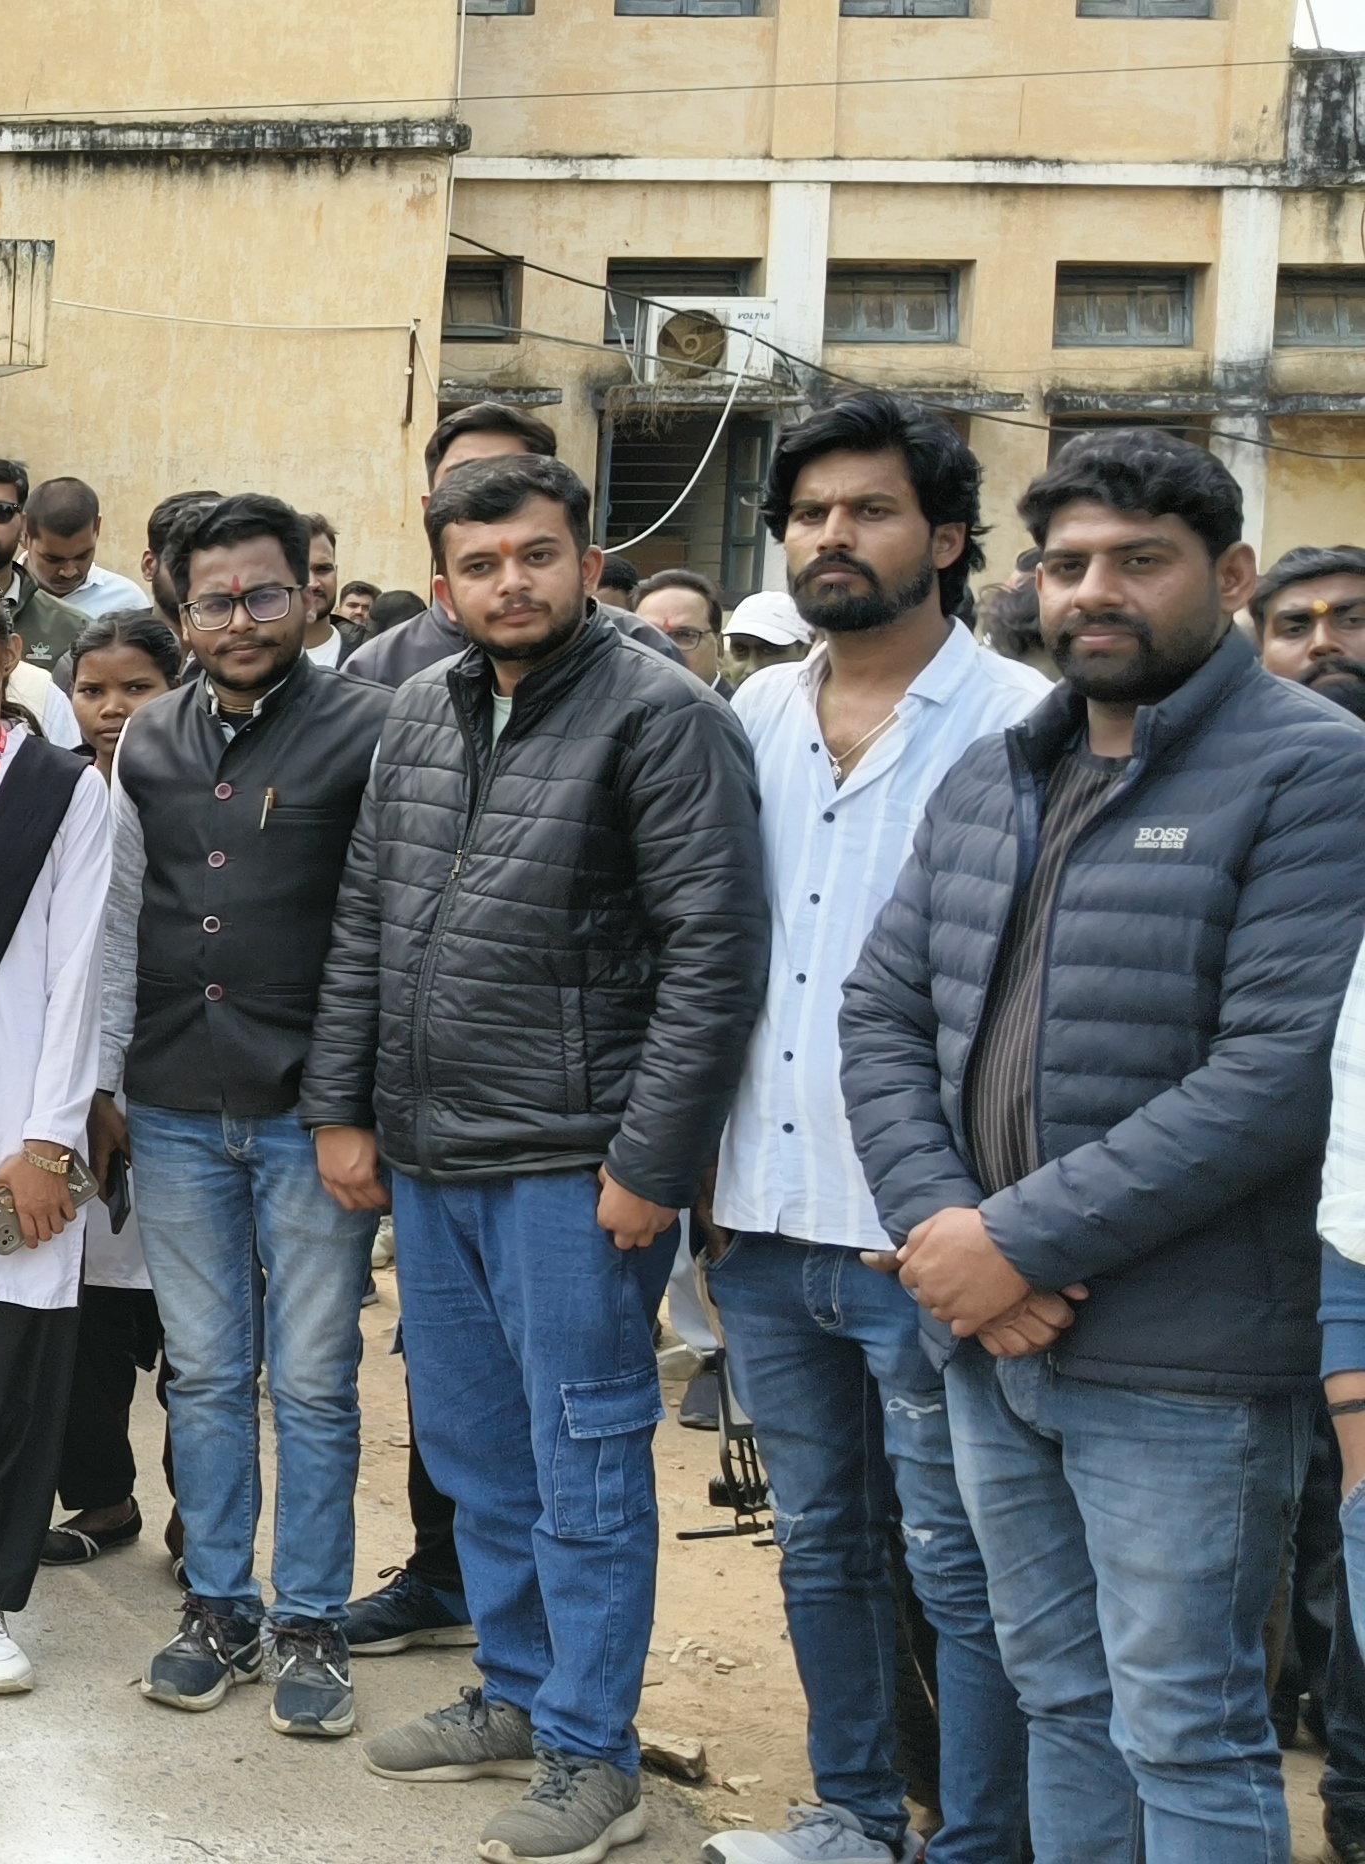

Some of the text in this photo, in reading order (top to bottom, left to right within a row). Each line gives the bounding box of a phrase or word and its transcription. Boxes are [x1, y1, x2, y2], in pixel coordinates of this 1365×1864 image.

[737, 312, 771, 320] VOLTAS
[1135, 827, 1189, 841] BOSS
[1160, 841, 1184, 849] BOSS
